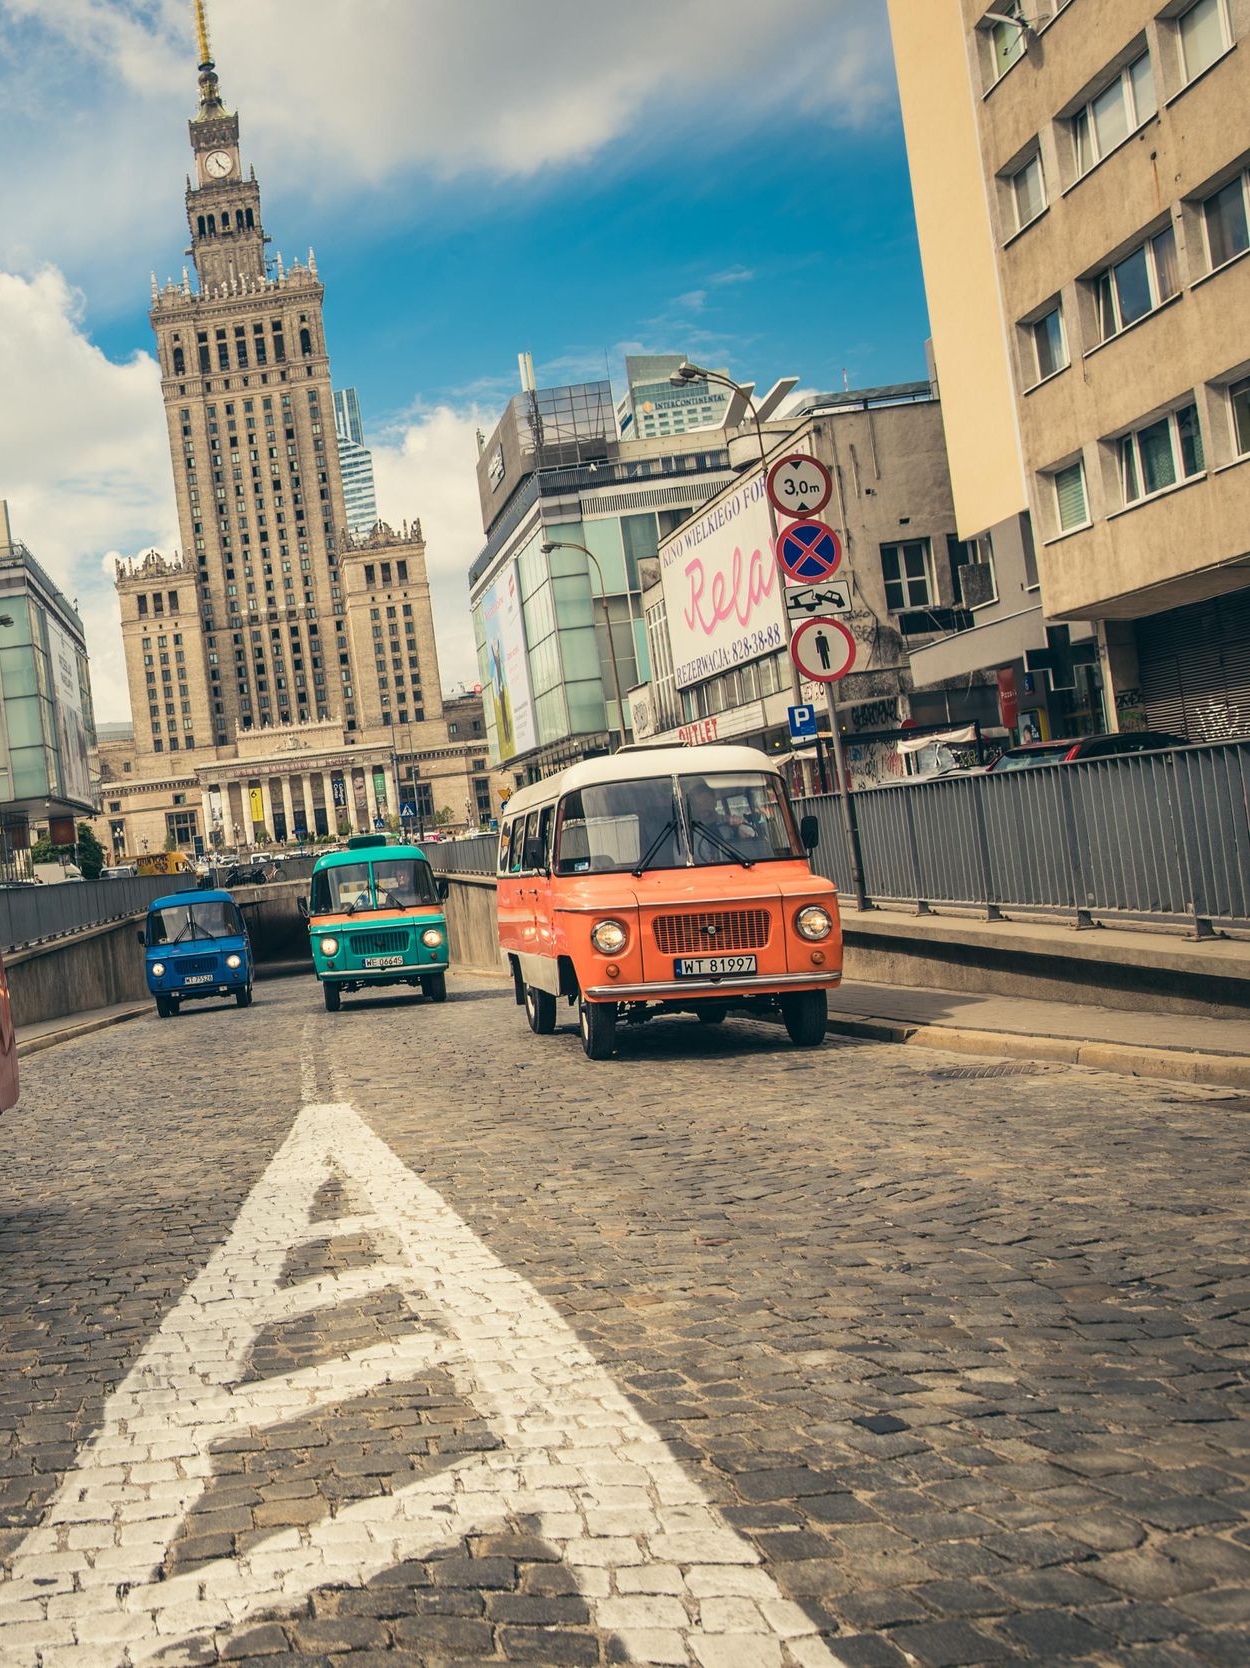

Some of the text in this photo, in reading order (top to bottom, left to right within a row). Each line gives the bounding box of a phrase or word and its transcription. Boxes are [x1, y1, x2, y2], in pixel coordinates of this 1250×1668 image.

[662, 539, 684, 568] KINO
[684, 495, 741, 548] WIELKIEGO
[684, 537, 777, 635] Rela
[676, 647, 732, 687] REZERWACJA:
[794, 708, 810, 727] P
[678, 718, 718, 747] OUTLET
[251, 790, 257, 799] 6
[684, 959, 703, 974] WT
[710, 957, 753, 973] 81997
